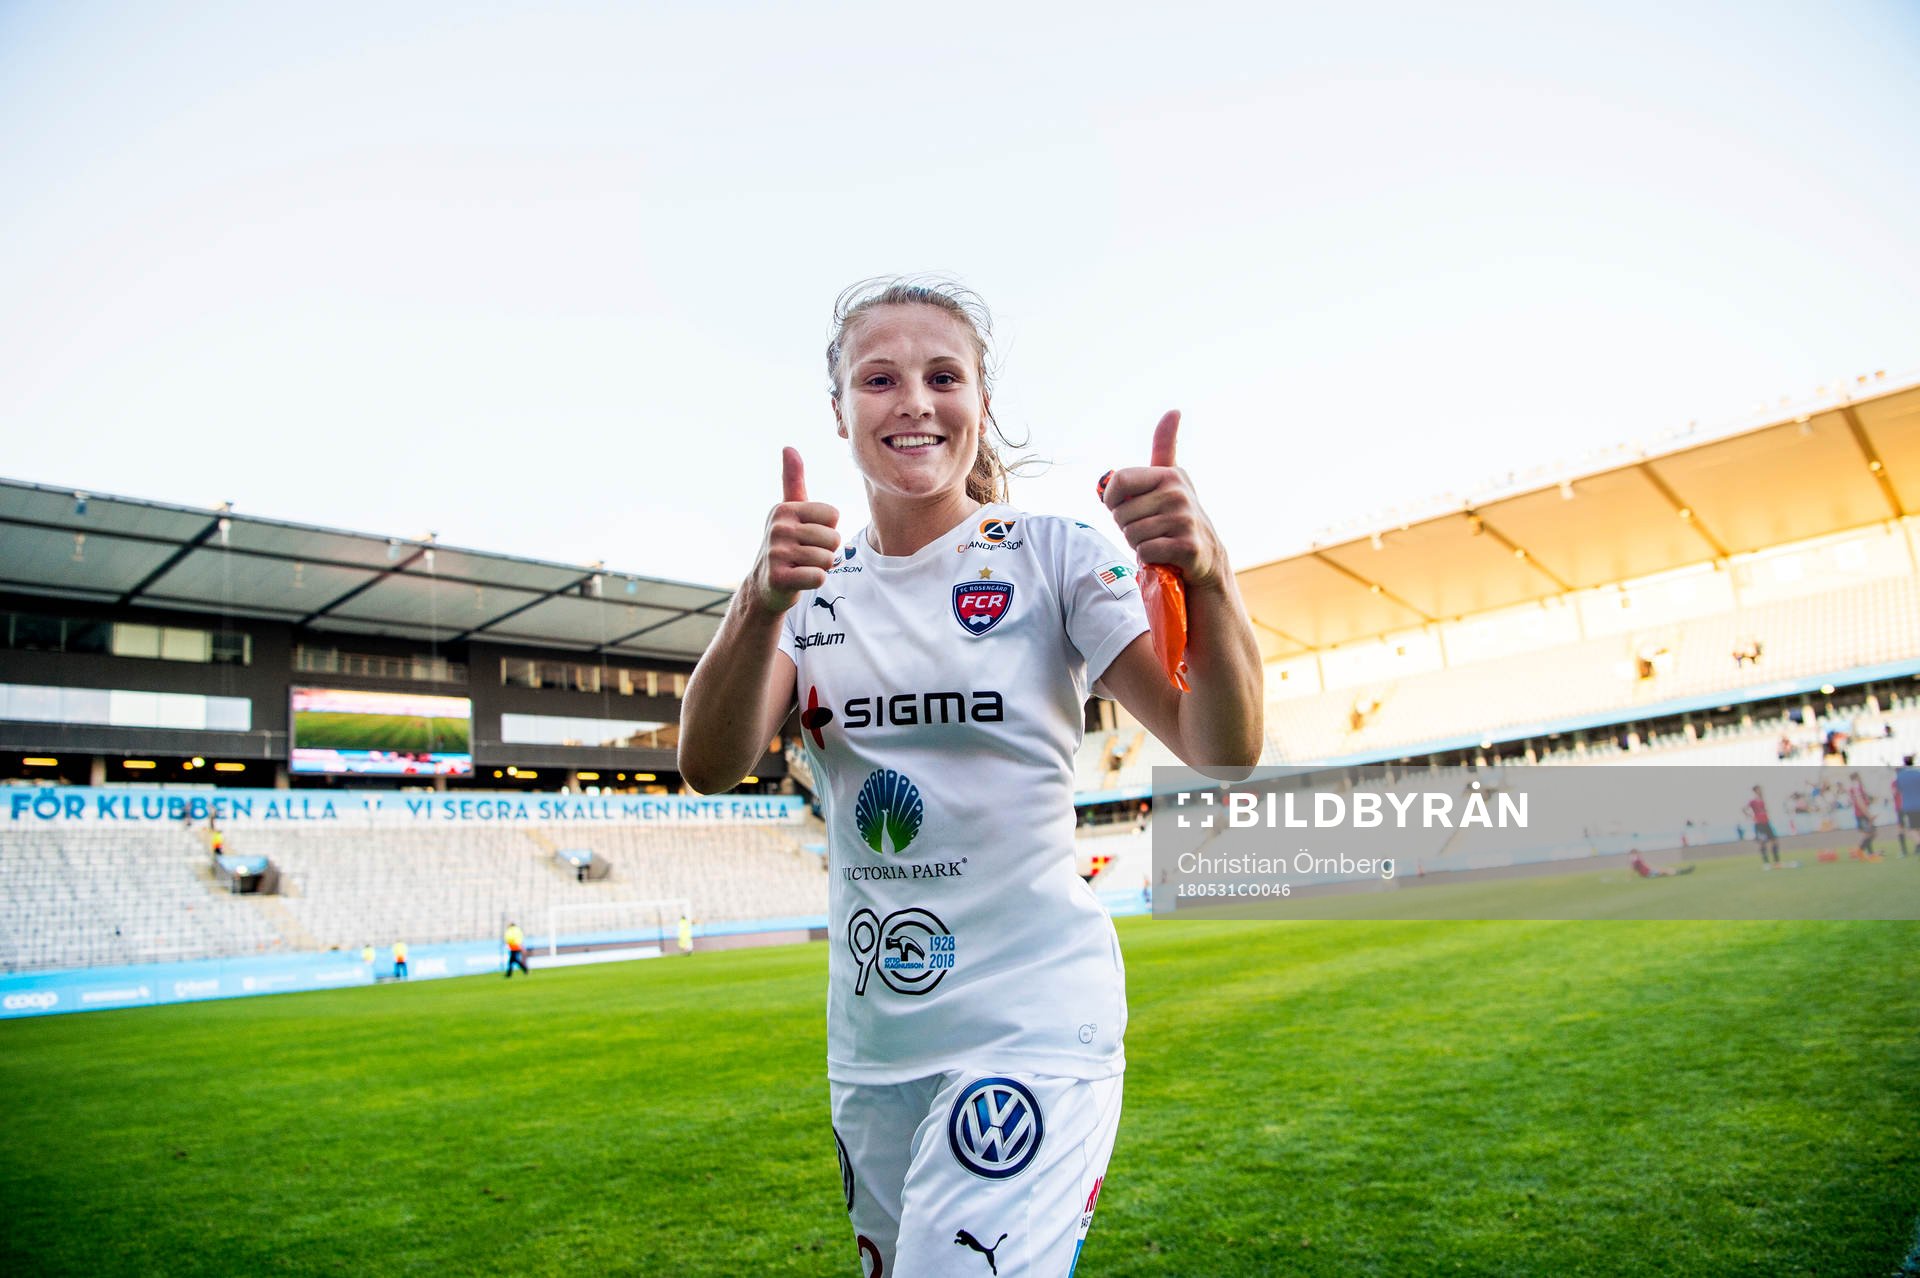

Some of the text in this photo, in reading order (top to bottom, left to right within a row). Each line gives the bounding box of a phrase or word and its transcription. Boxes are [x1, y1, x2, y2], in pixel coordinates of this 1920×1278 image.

[961, 594, 1003, 608] FCR
[11, 788, 789, 820] FÖR KLUBBEN ALLA VI SEGRA SKALL MEN INTE FALLA
[930, 936, 955, 951] 1928
[929, 953, 955, 969] 2018
